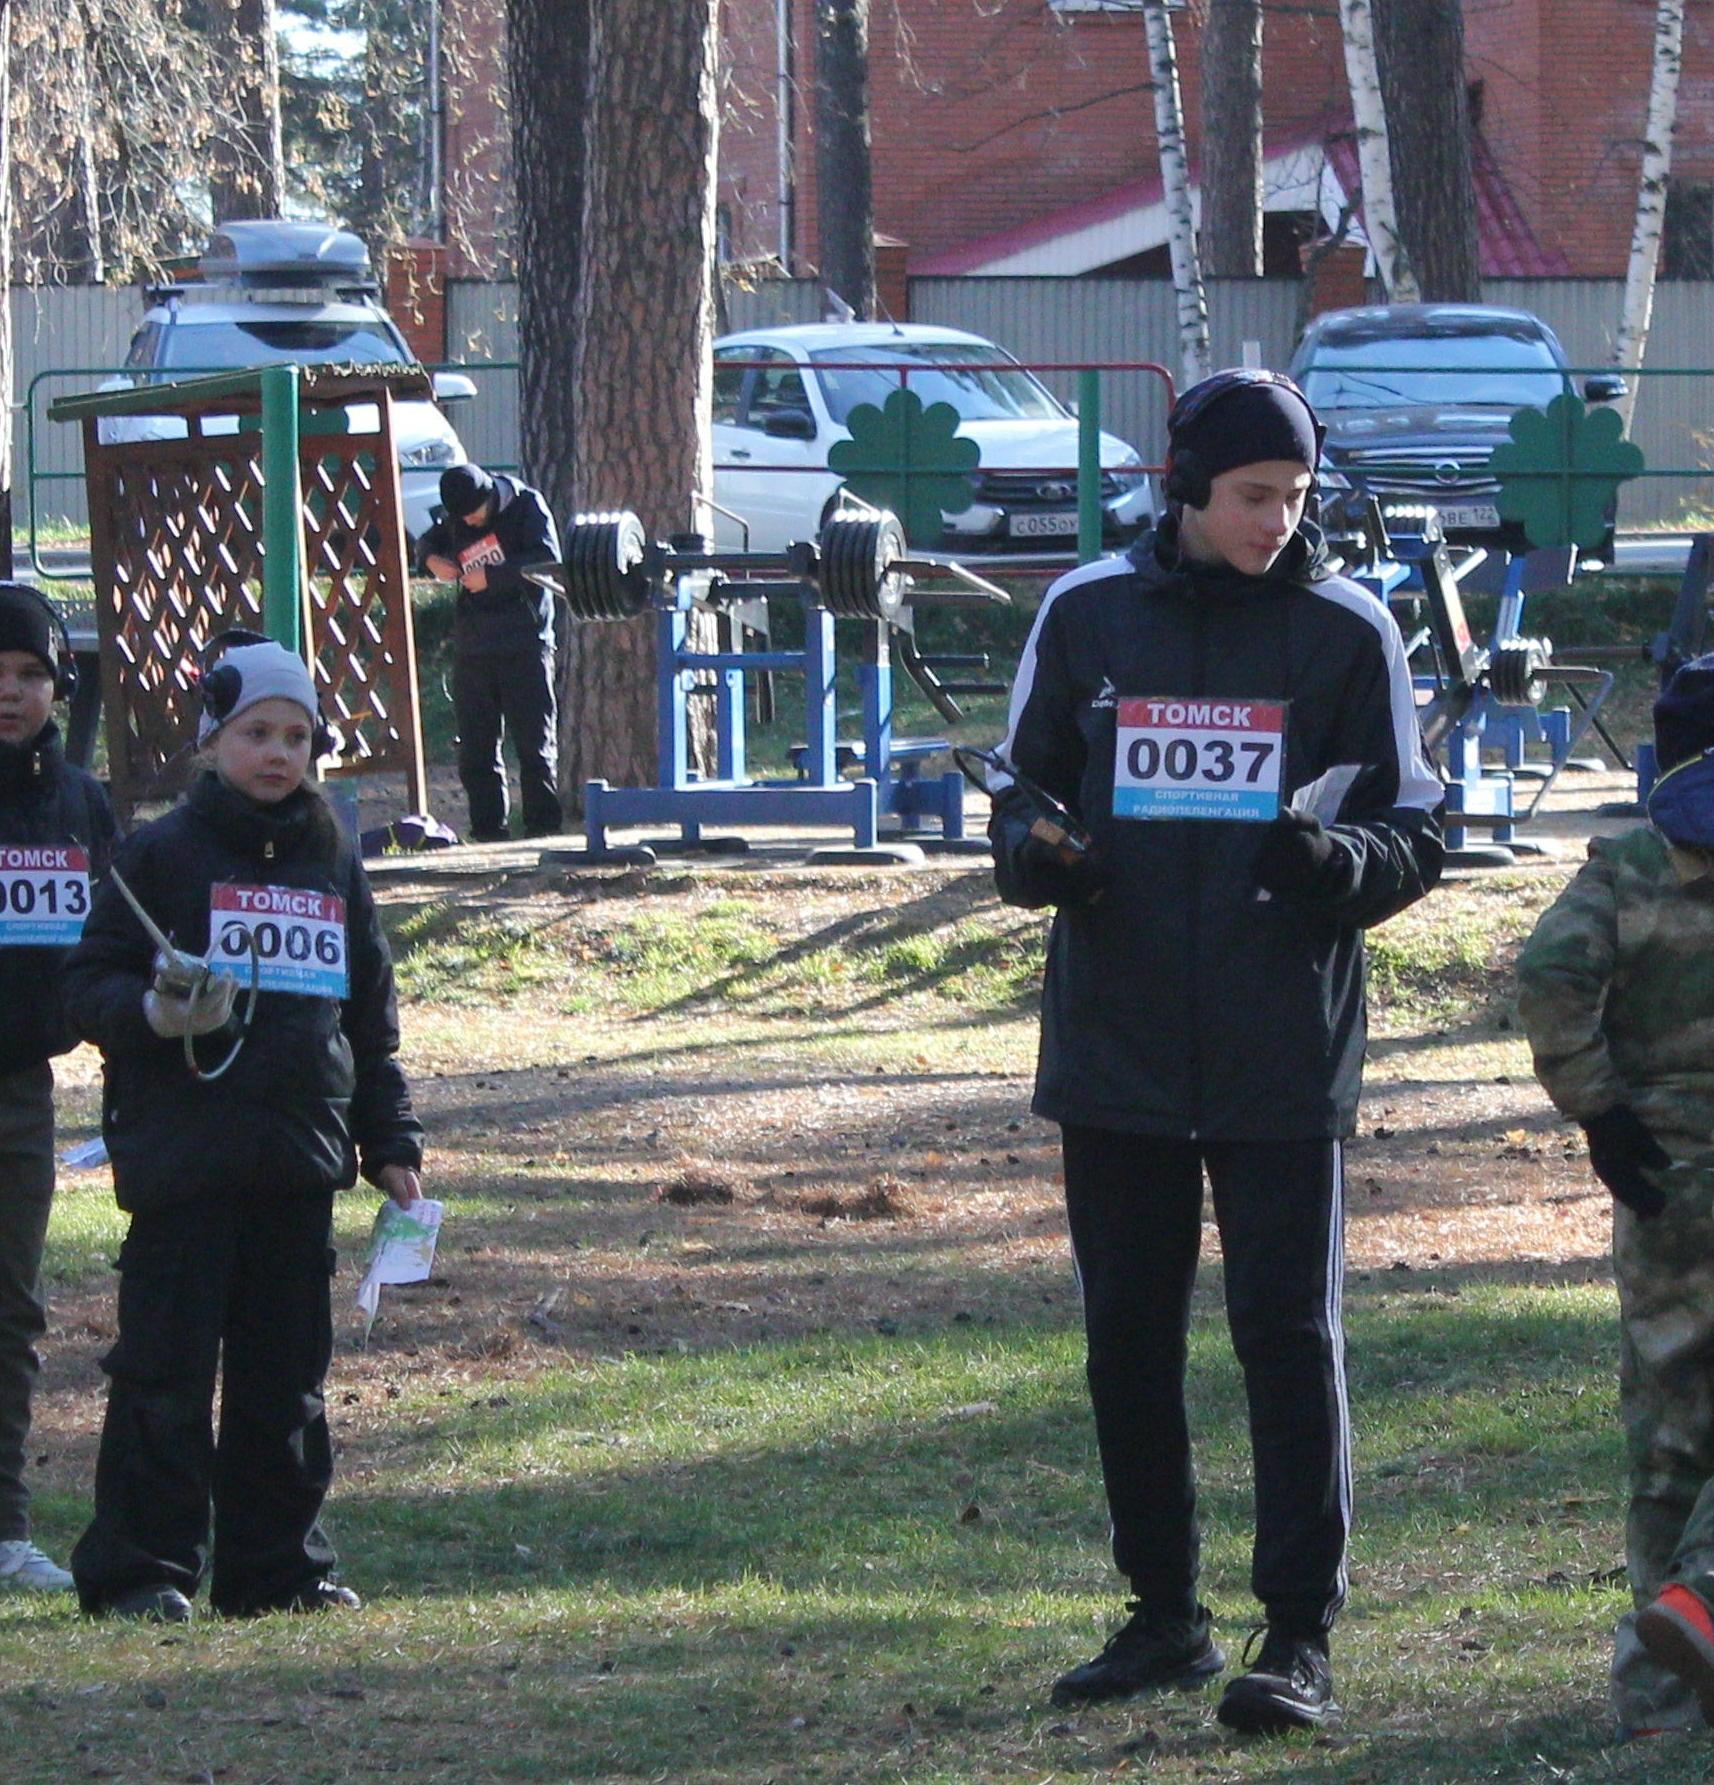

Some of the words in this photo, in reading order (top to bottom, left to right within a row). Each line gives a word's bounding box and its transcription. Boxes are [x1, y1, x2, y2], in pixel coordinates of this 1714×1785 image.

[1147, 703, 1252, 727] ТОМСК
[1127, 738, 1274, 783] 0037
[1155, 790, 1238, 801] СПОРТИВНАЯ
[237, 890, 321, 917] ТОМСК
[220, 920, 341, 965] 0006
